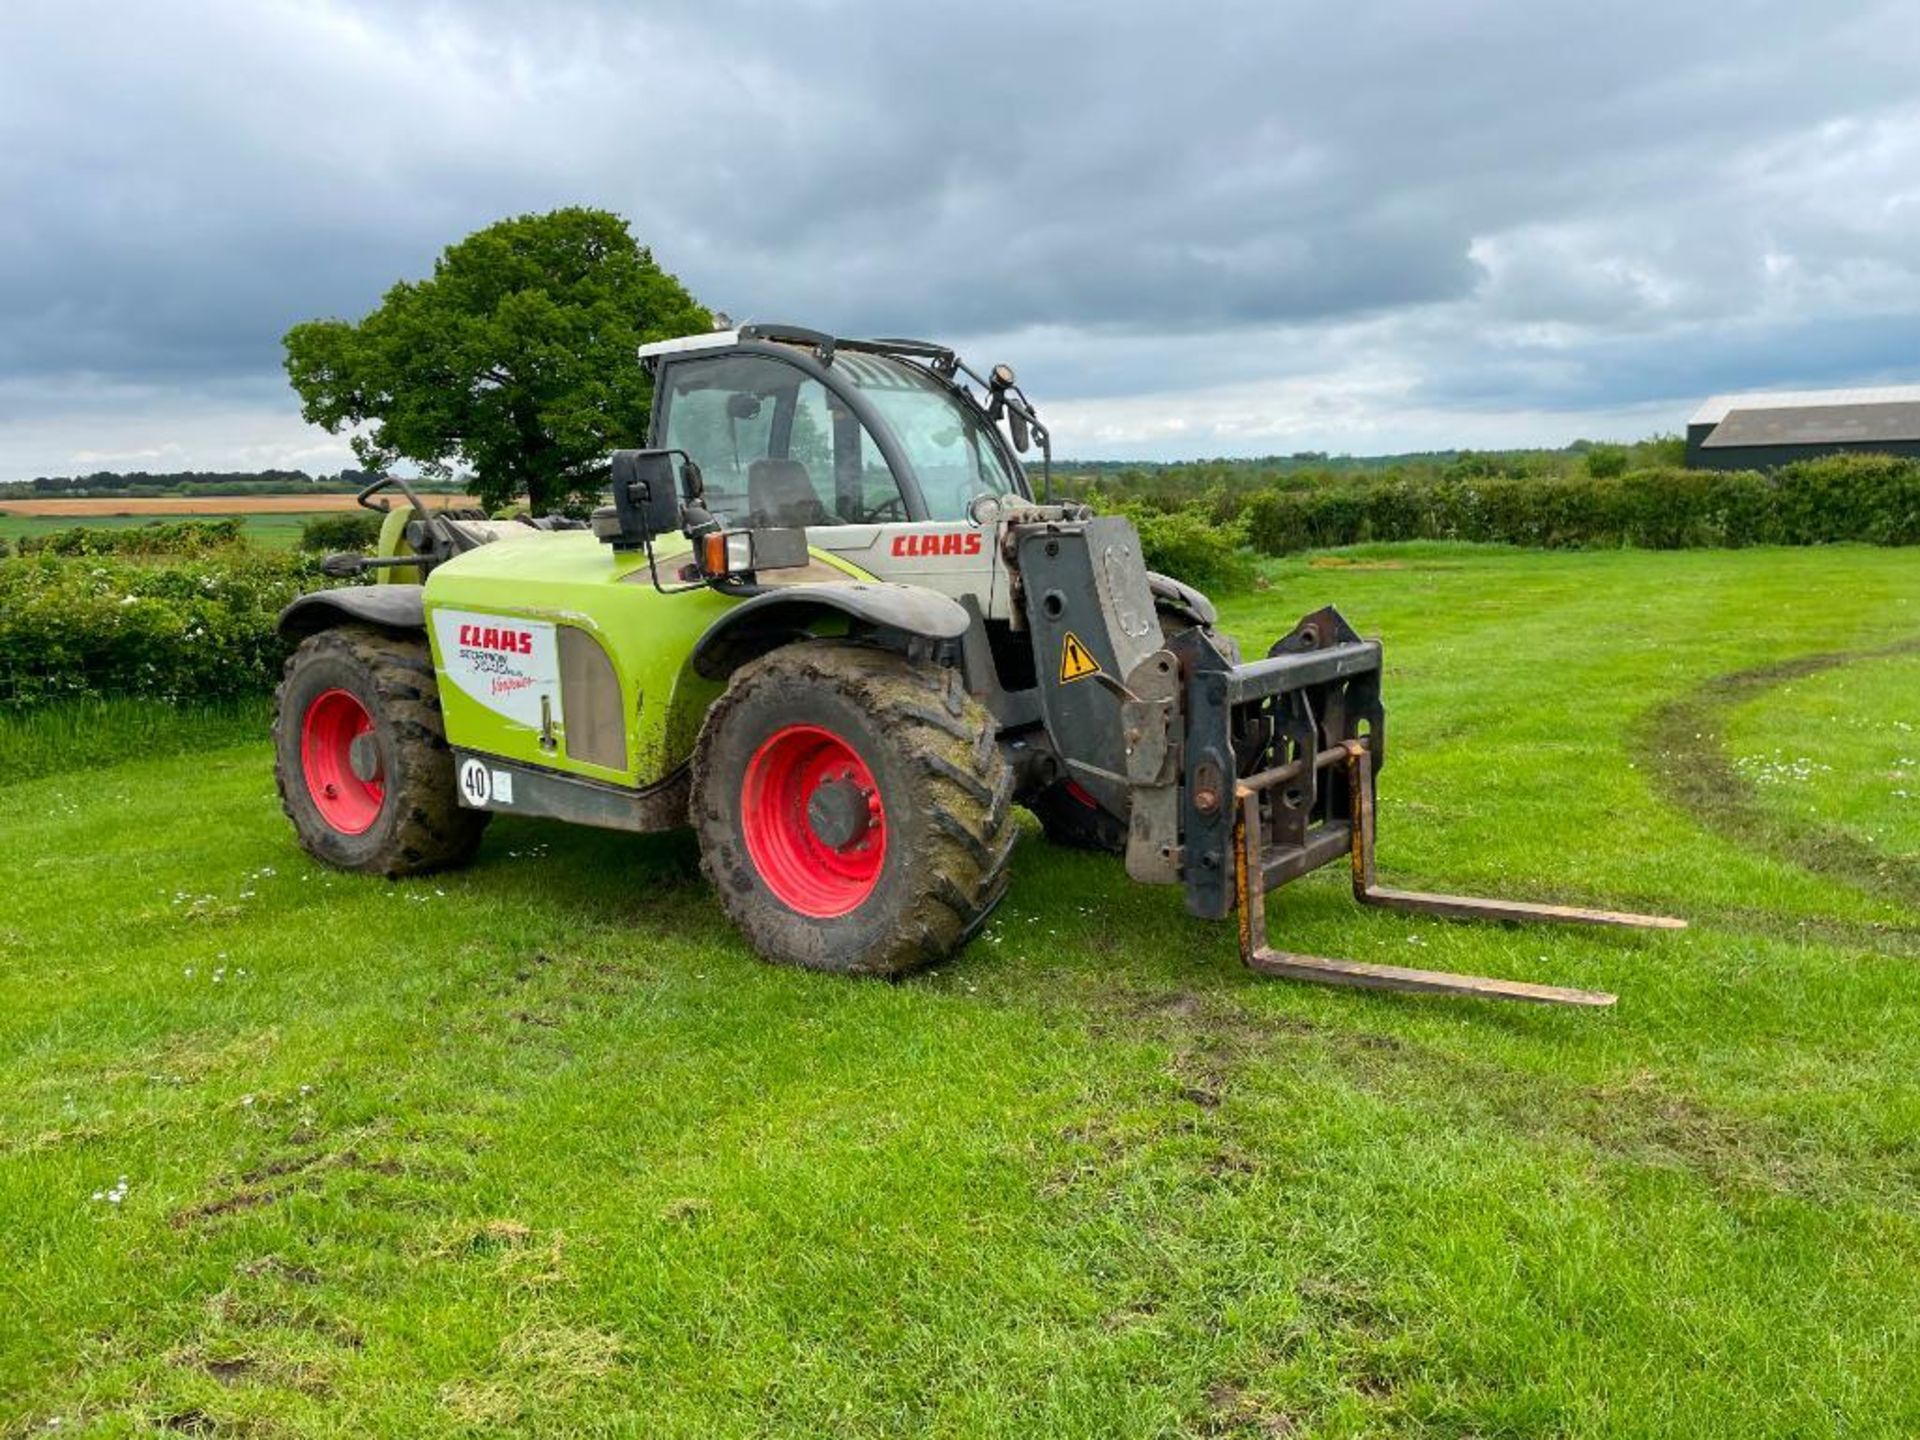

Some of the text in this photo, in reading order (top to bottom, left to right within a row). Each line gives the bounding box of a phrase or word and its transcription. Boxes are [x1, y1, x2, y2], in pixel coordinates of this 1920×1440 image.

[892, 533, 982, 556] CLAAS
[460, 625, 532, 654] CLAAS
[465, 766, 484, 798] 40
